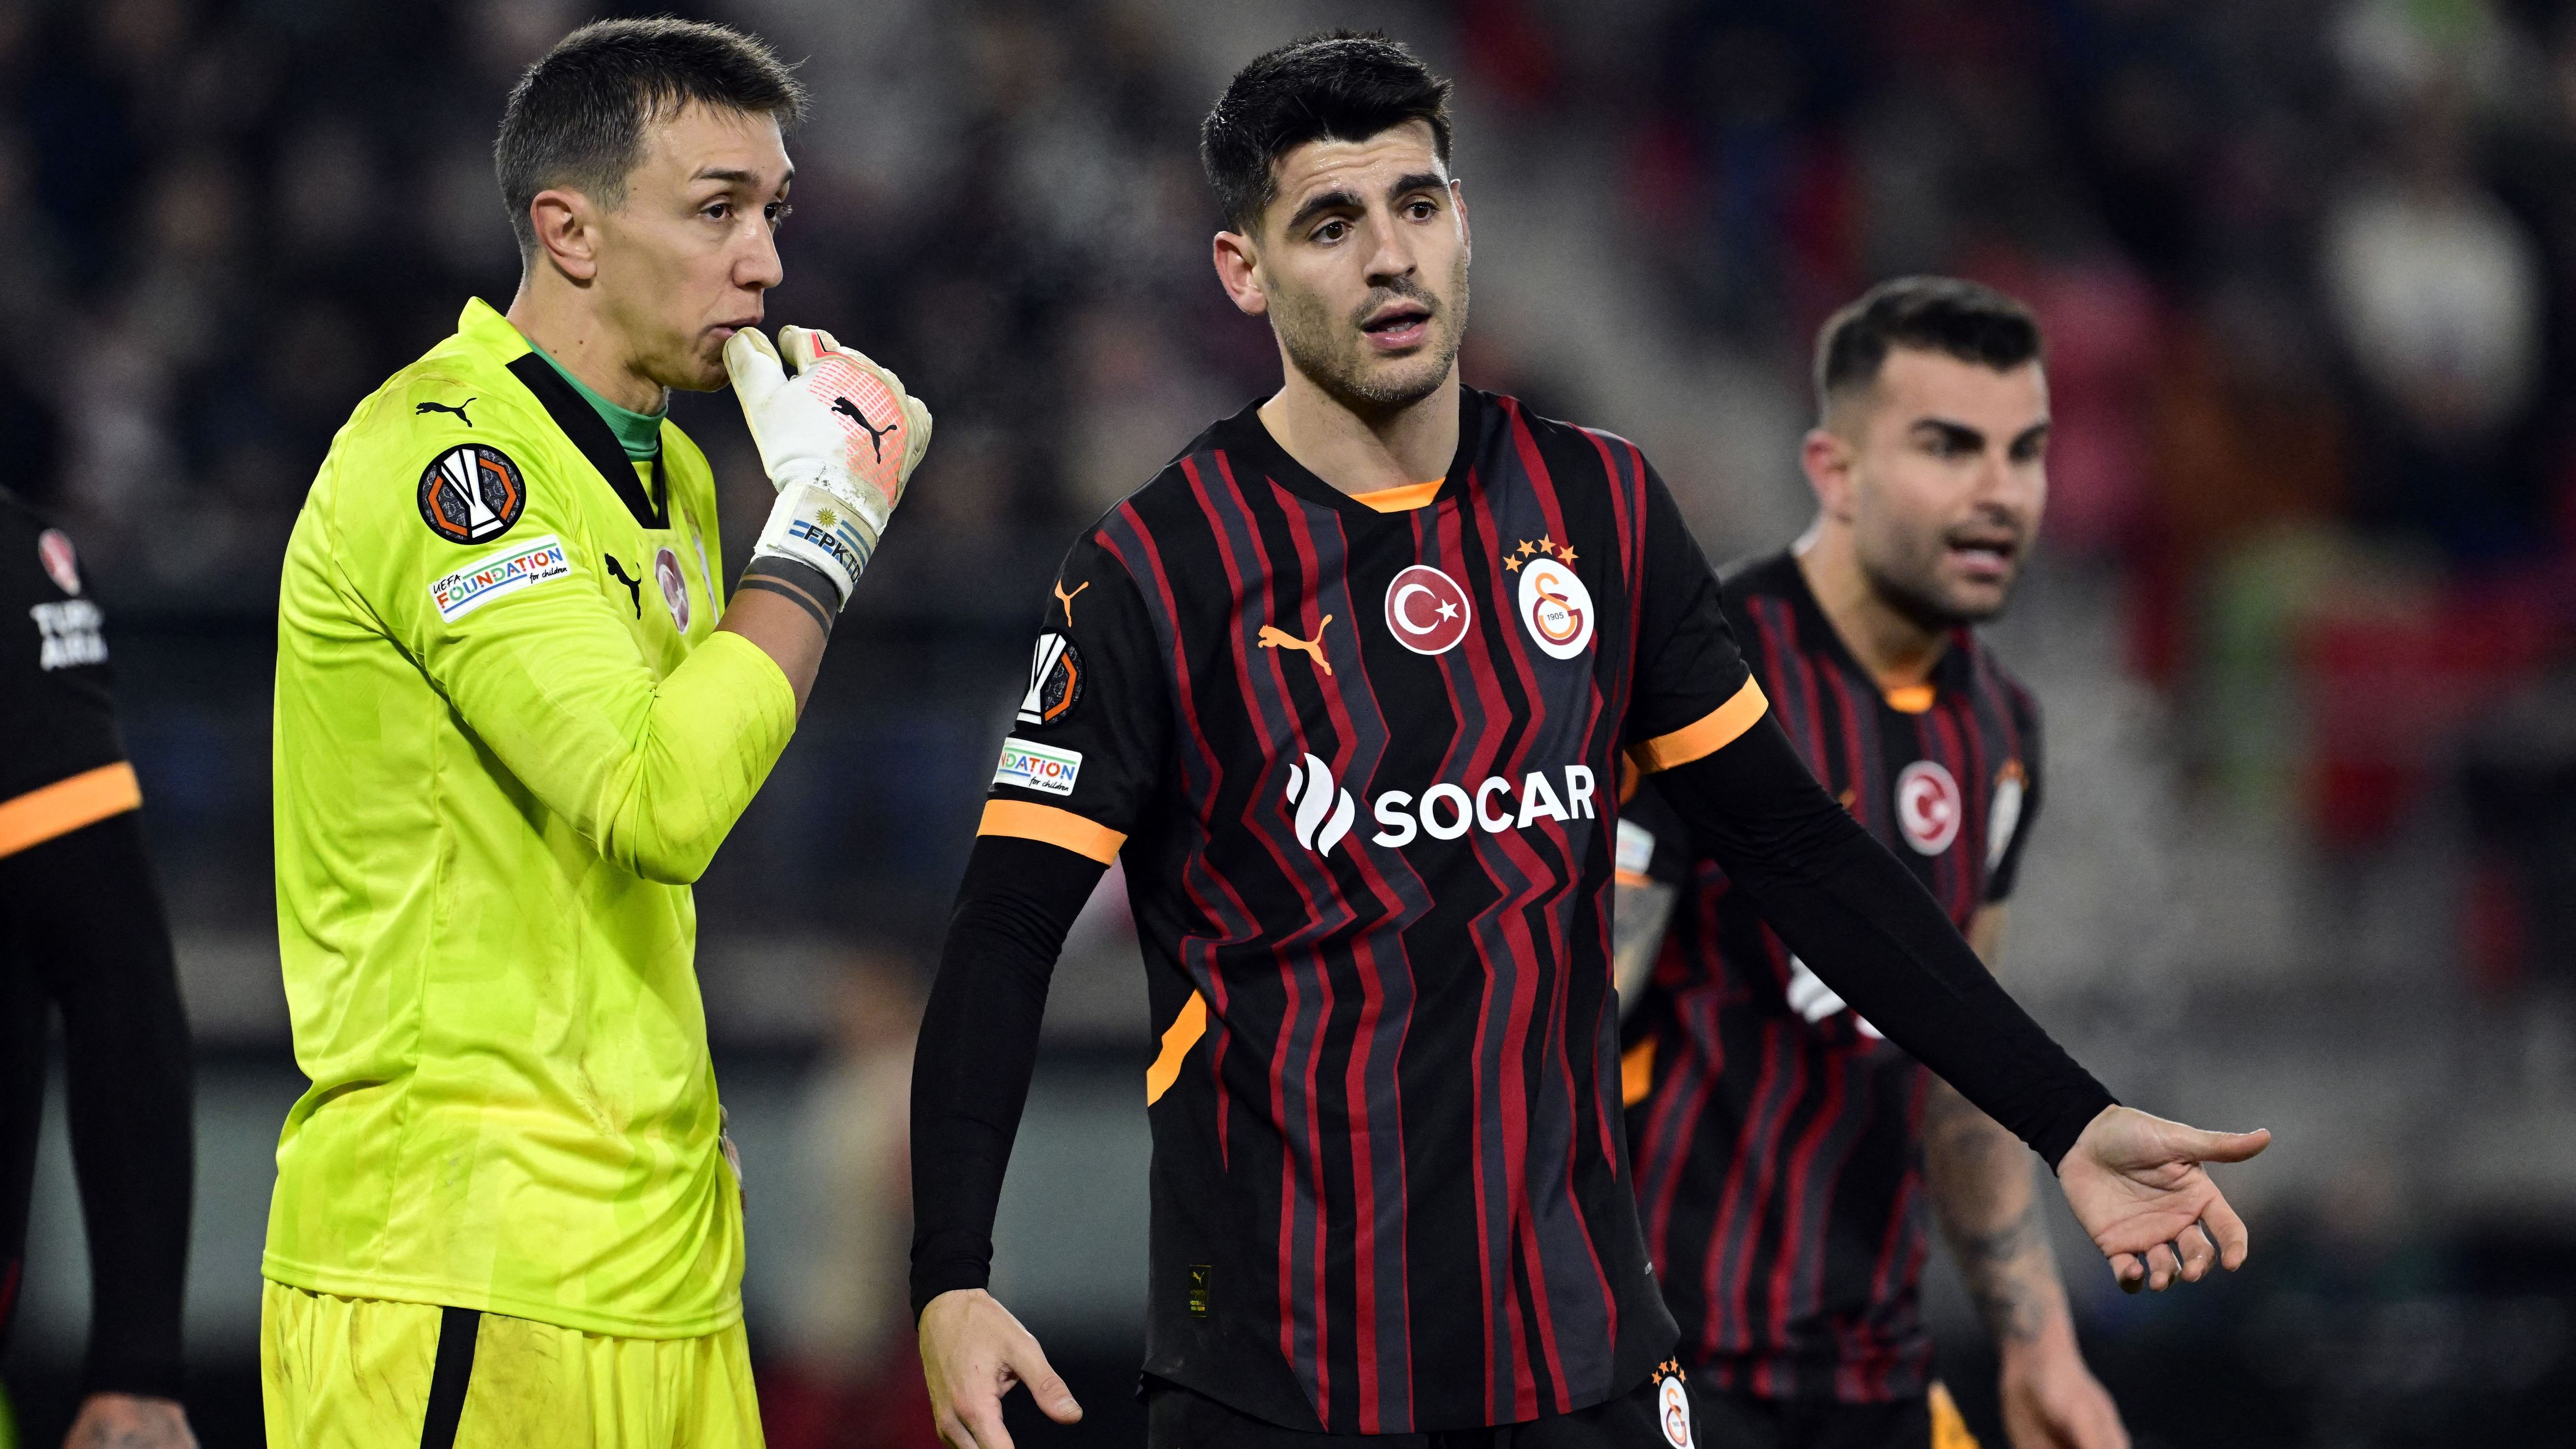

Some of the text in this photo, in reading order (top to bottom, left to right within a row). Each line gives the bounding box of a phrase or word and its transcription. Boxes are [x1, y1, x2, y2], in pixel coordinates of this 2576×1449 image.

[433, 574, 461, 594] UEFA
[437, 547, 563, 609] FOUNDATION
[530, 567, 568, 584] for children
[1546, 612, 1564, 621] 1905
[1029, 776, 1069, 792] for children
[1371, 764, 1595, 848] SOCAR
